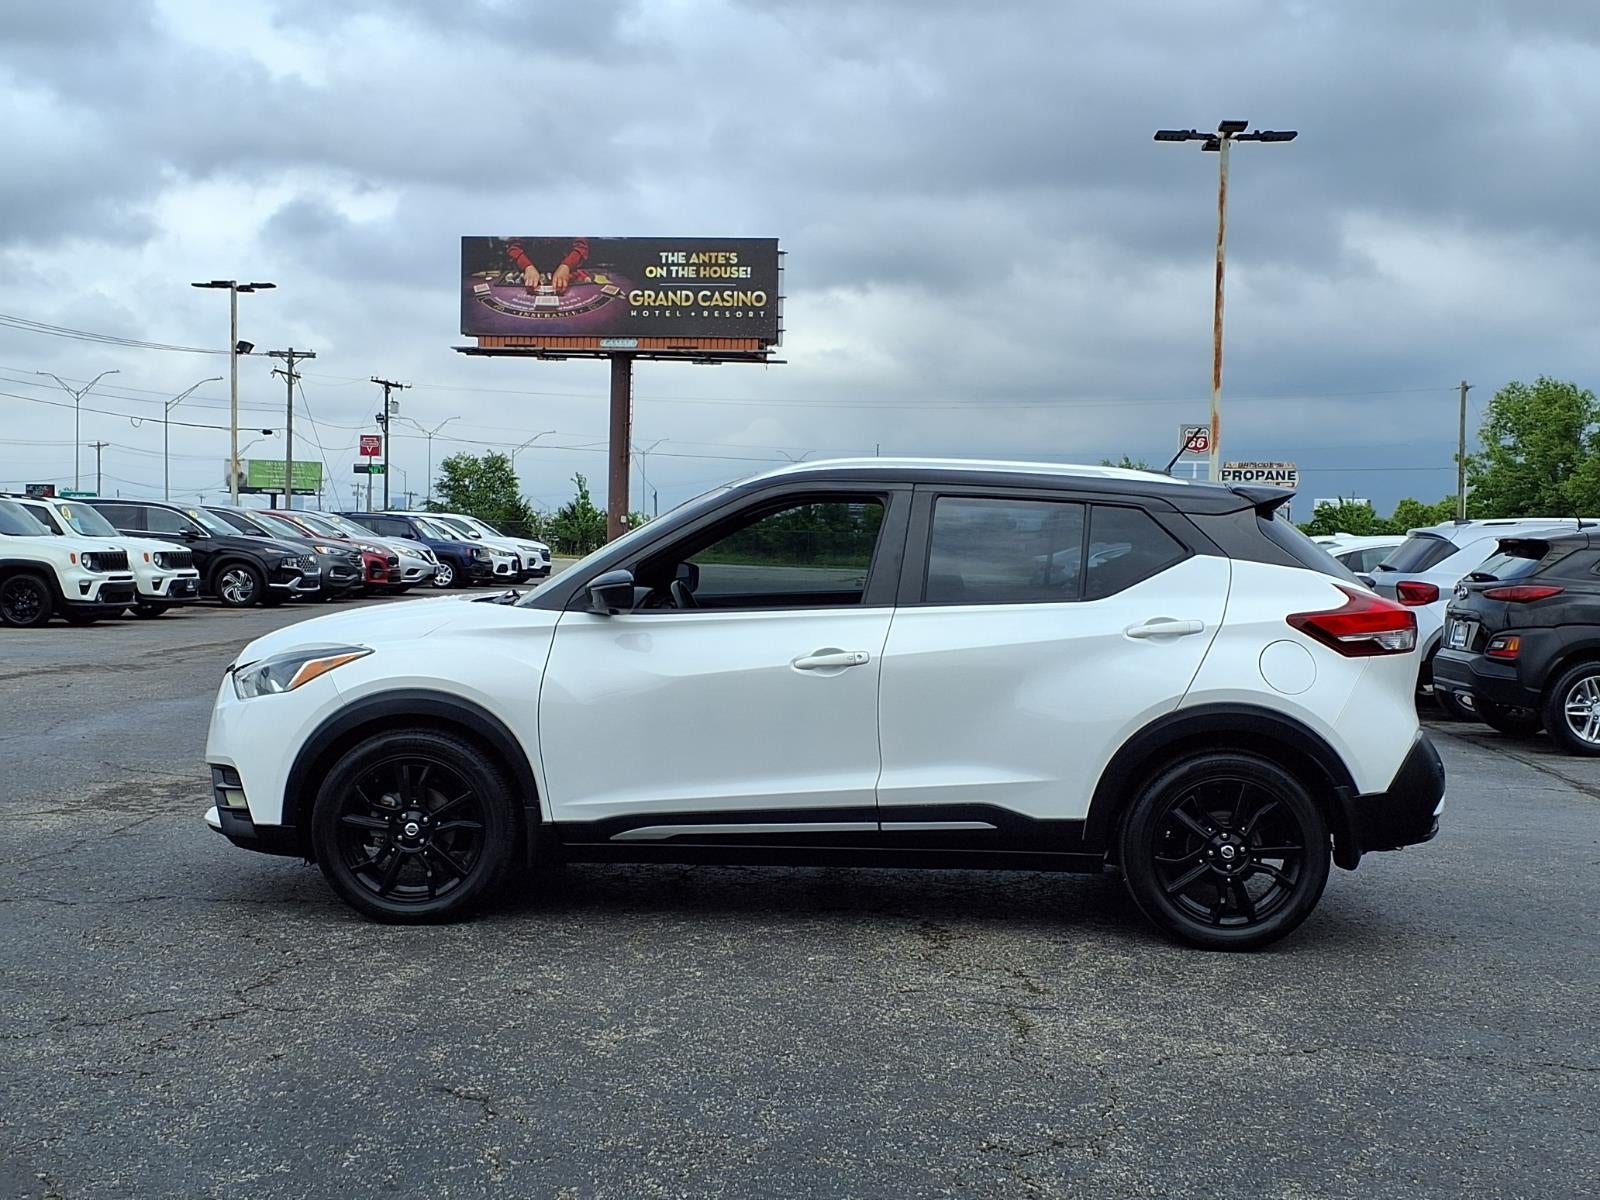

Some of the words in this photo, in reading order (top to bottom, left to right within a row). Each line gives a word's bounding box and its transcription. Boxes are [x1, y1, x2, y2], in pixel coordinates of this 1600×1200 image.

[659, 252, 687, 264] THE
[689, 252, 738, 264] ANTE'S
[645, 266, 667, 278] ON
[670, 266, 697, 278] THE
[699, 266, 751, 278] HOUSE!
[628, 290, 694, 306] GRAND
[697, 290, 767, 307] CASINO
[1187, 437, 1206, 448] 66
[1221, 470, 1296, 481] PROPANE
